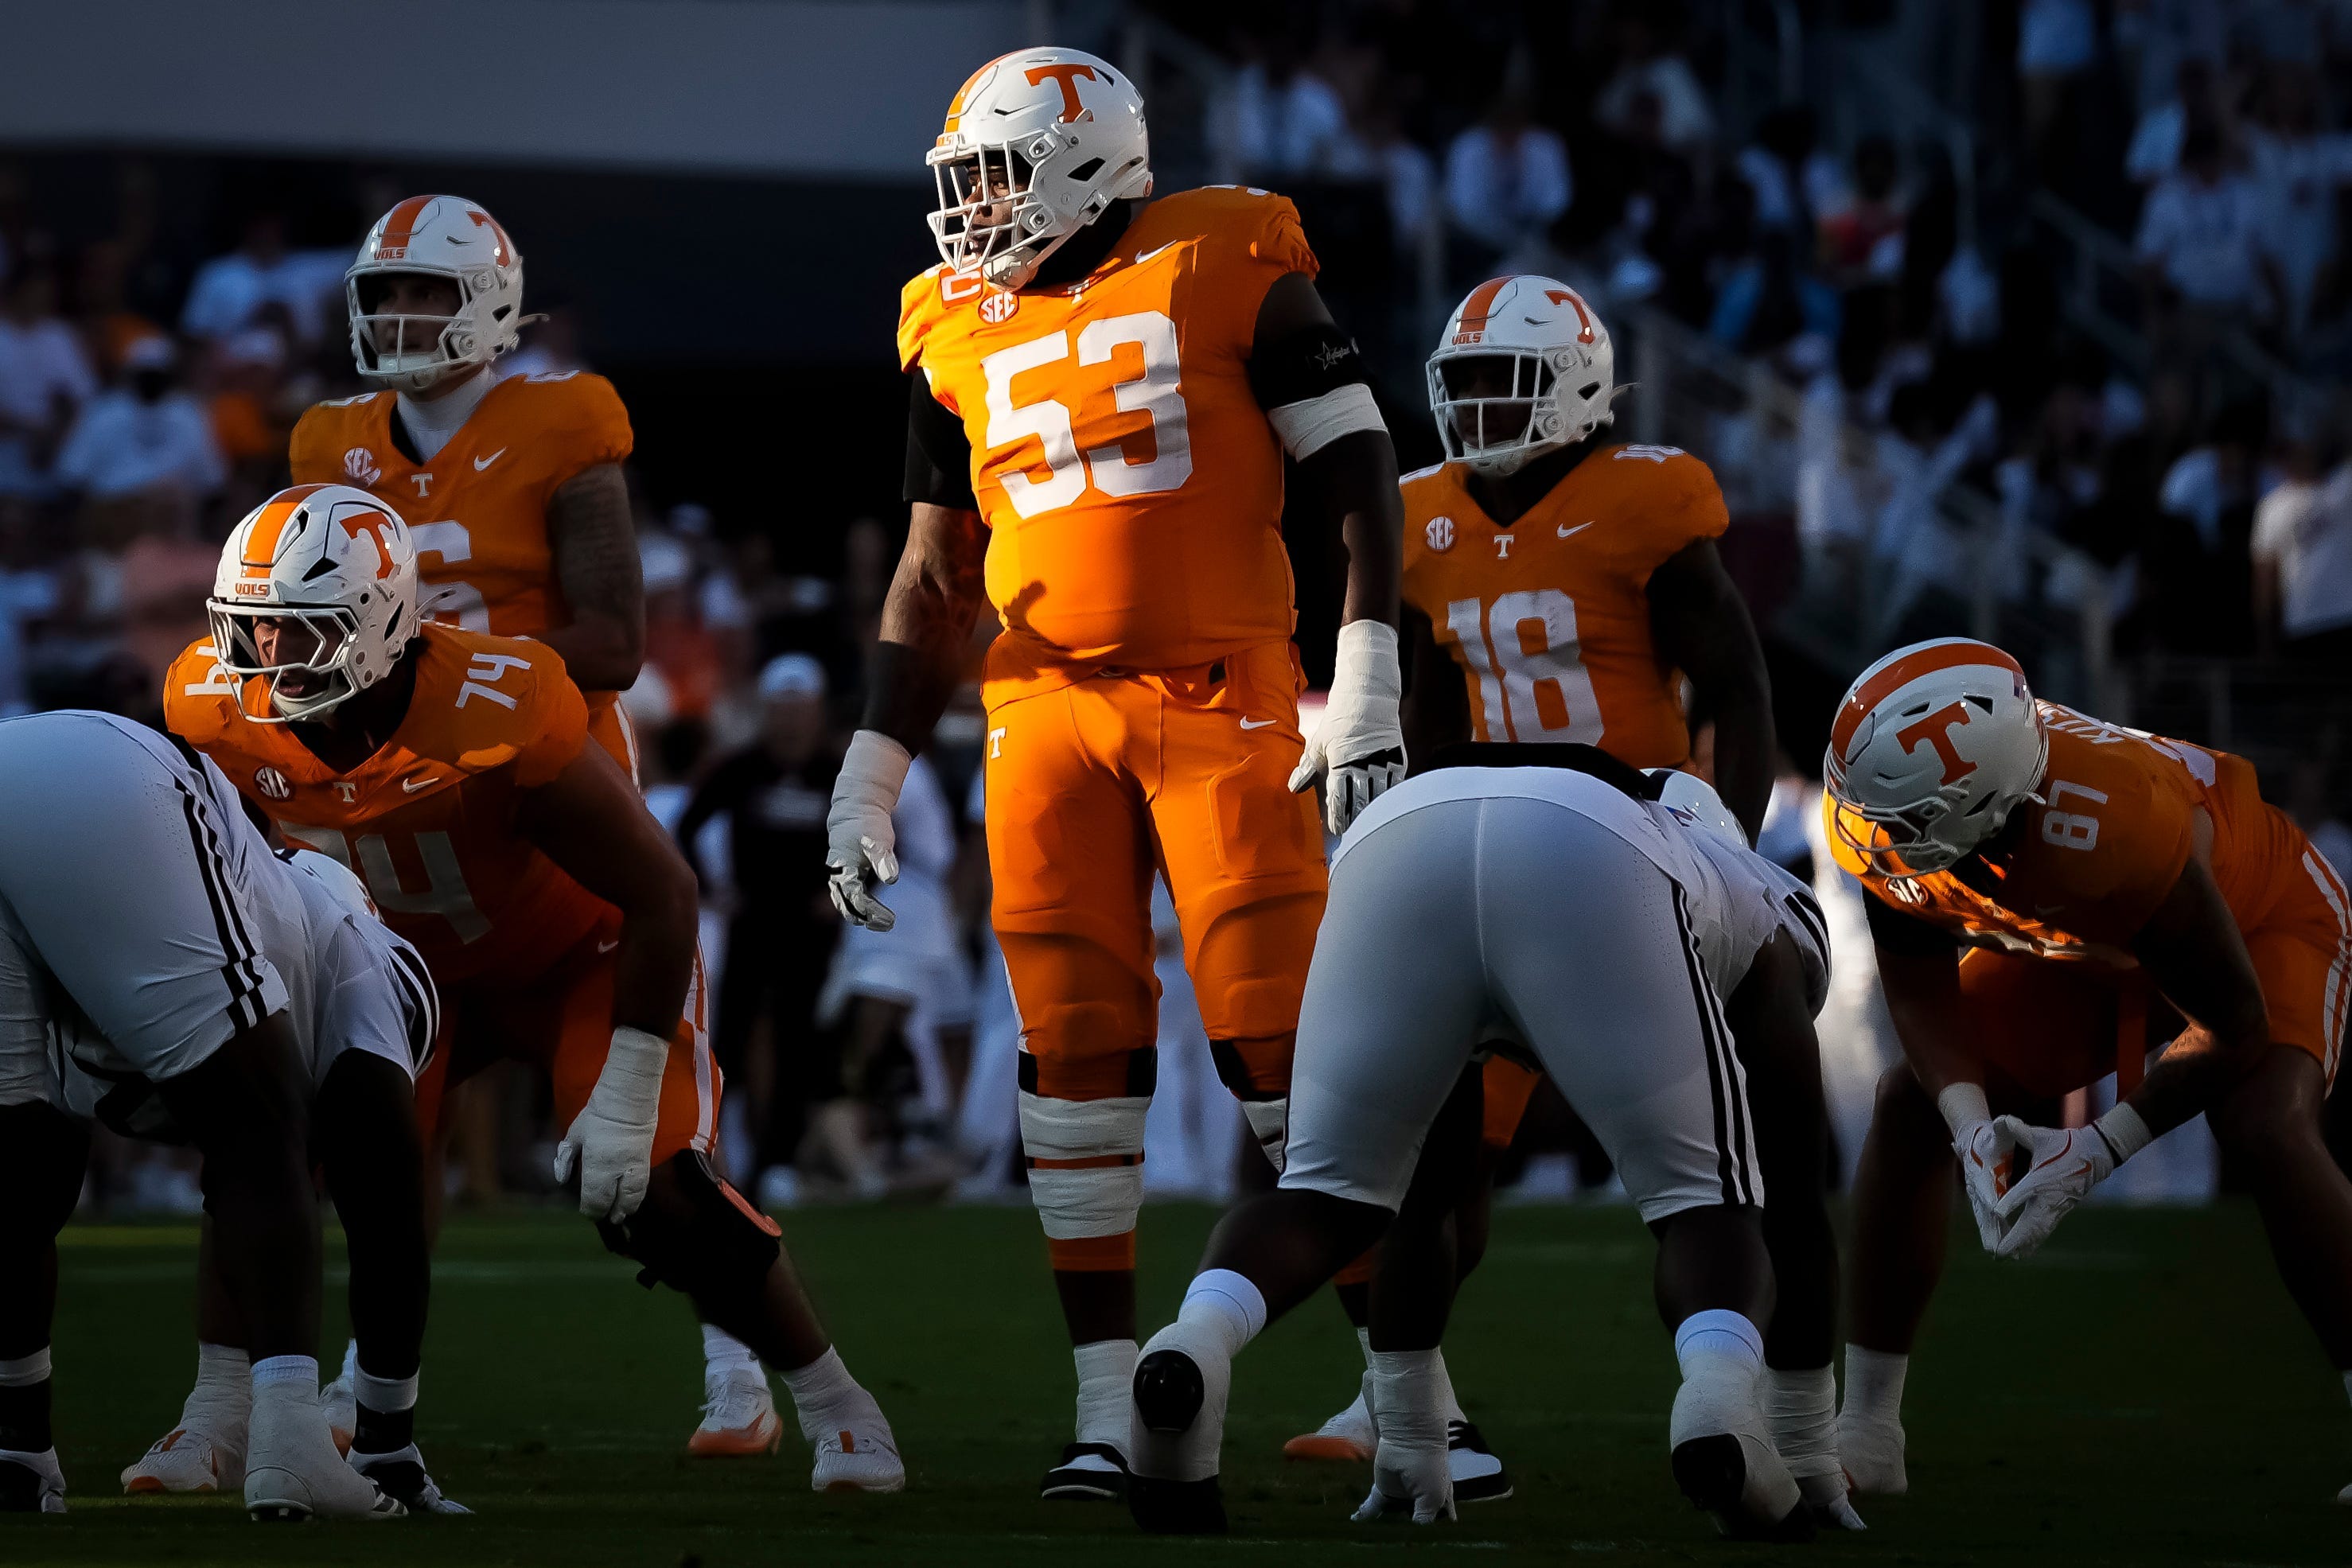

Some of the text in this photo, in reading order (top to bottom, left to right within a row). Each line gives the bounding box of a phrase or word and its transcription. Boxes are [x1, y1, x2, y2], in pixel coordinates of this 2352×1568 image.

[1024, 64, 1096, 123] T
[374, 248, 405, 261] VOLS
[940, 270, 982, 302] C
[980, 290, 1016, 323] SEC
[1451, 332, 1482, 345] VOLS
[979, 309, 1194, 520] 53
[343, 447, 382, 487] SEC
[411, 473, 434, 498] T
[339, 511, 395, 581] T
[1425, 516, 1456, 551] SEC
[1493, 534, 1515, 560] T
[235, 582, 271, 597] VOLS
[454, 652, 532, 712] 74
[1447, 587, 1606, 747] 18
[989, 726, 1007, 759] T
[1895, 701, 1978, 787] T
[254, 766, 293, 800] SEC
[333, 781, 357, 803] T
[2041, 779, 2109, 853] 87
